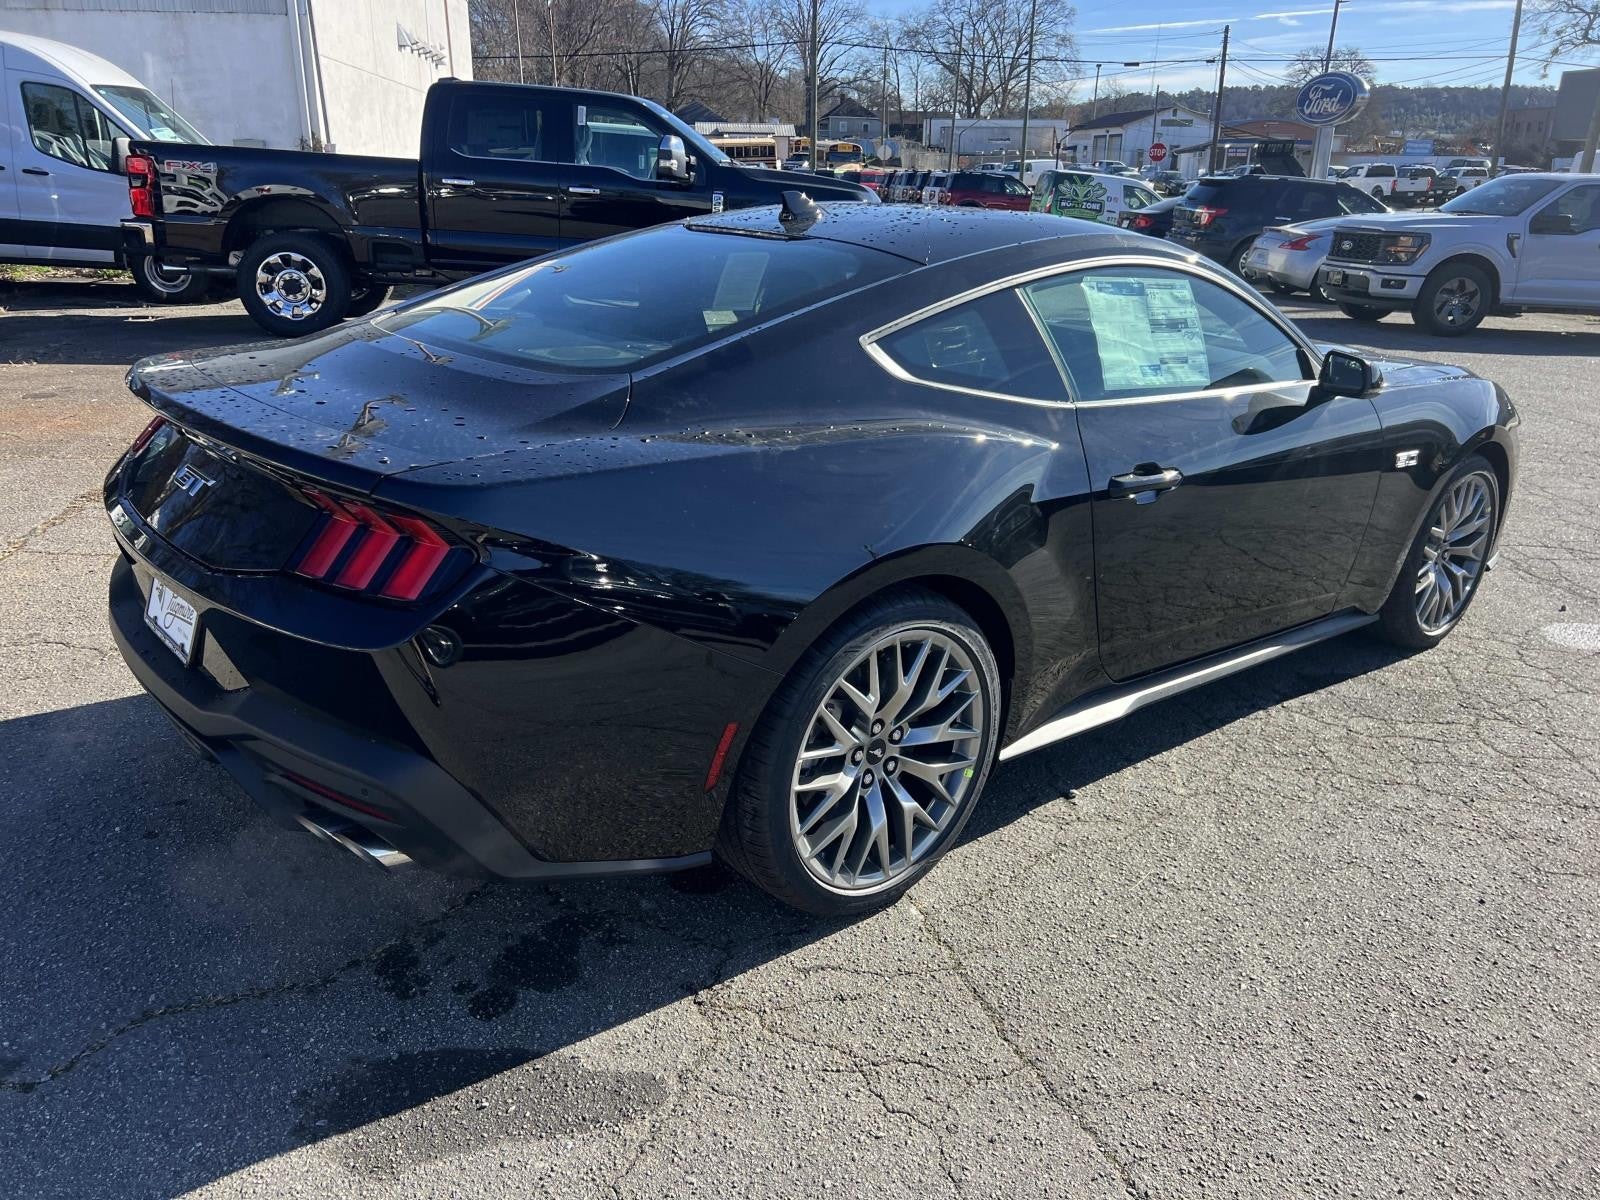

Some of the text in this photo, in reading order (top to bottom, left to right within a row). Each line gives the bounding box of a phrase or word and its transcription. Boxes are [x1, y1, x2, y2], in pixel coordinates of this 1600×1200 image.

[1304, 83, 1343, 114] Ford
[1149, 148, 1167, 157] STOP
[165, 160, 218, 173] FX4
[1082, 202, 1101, 210] ZONE
[173, 464, 217, 497] GT
